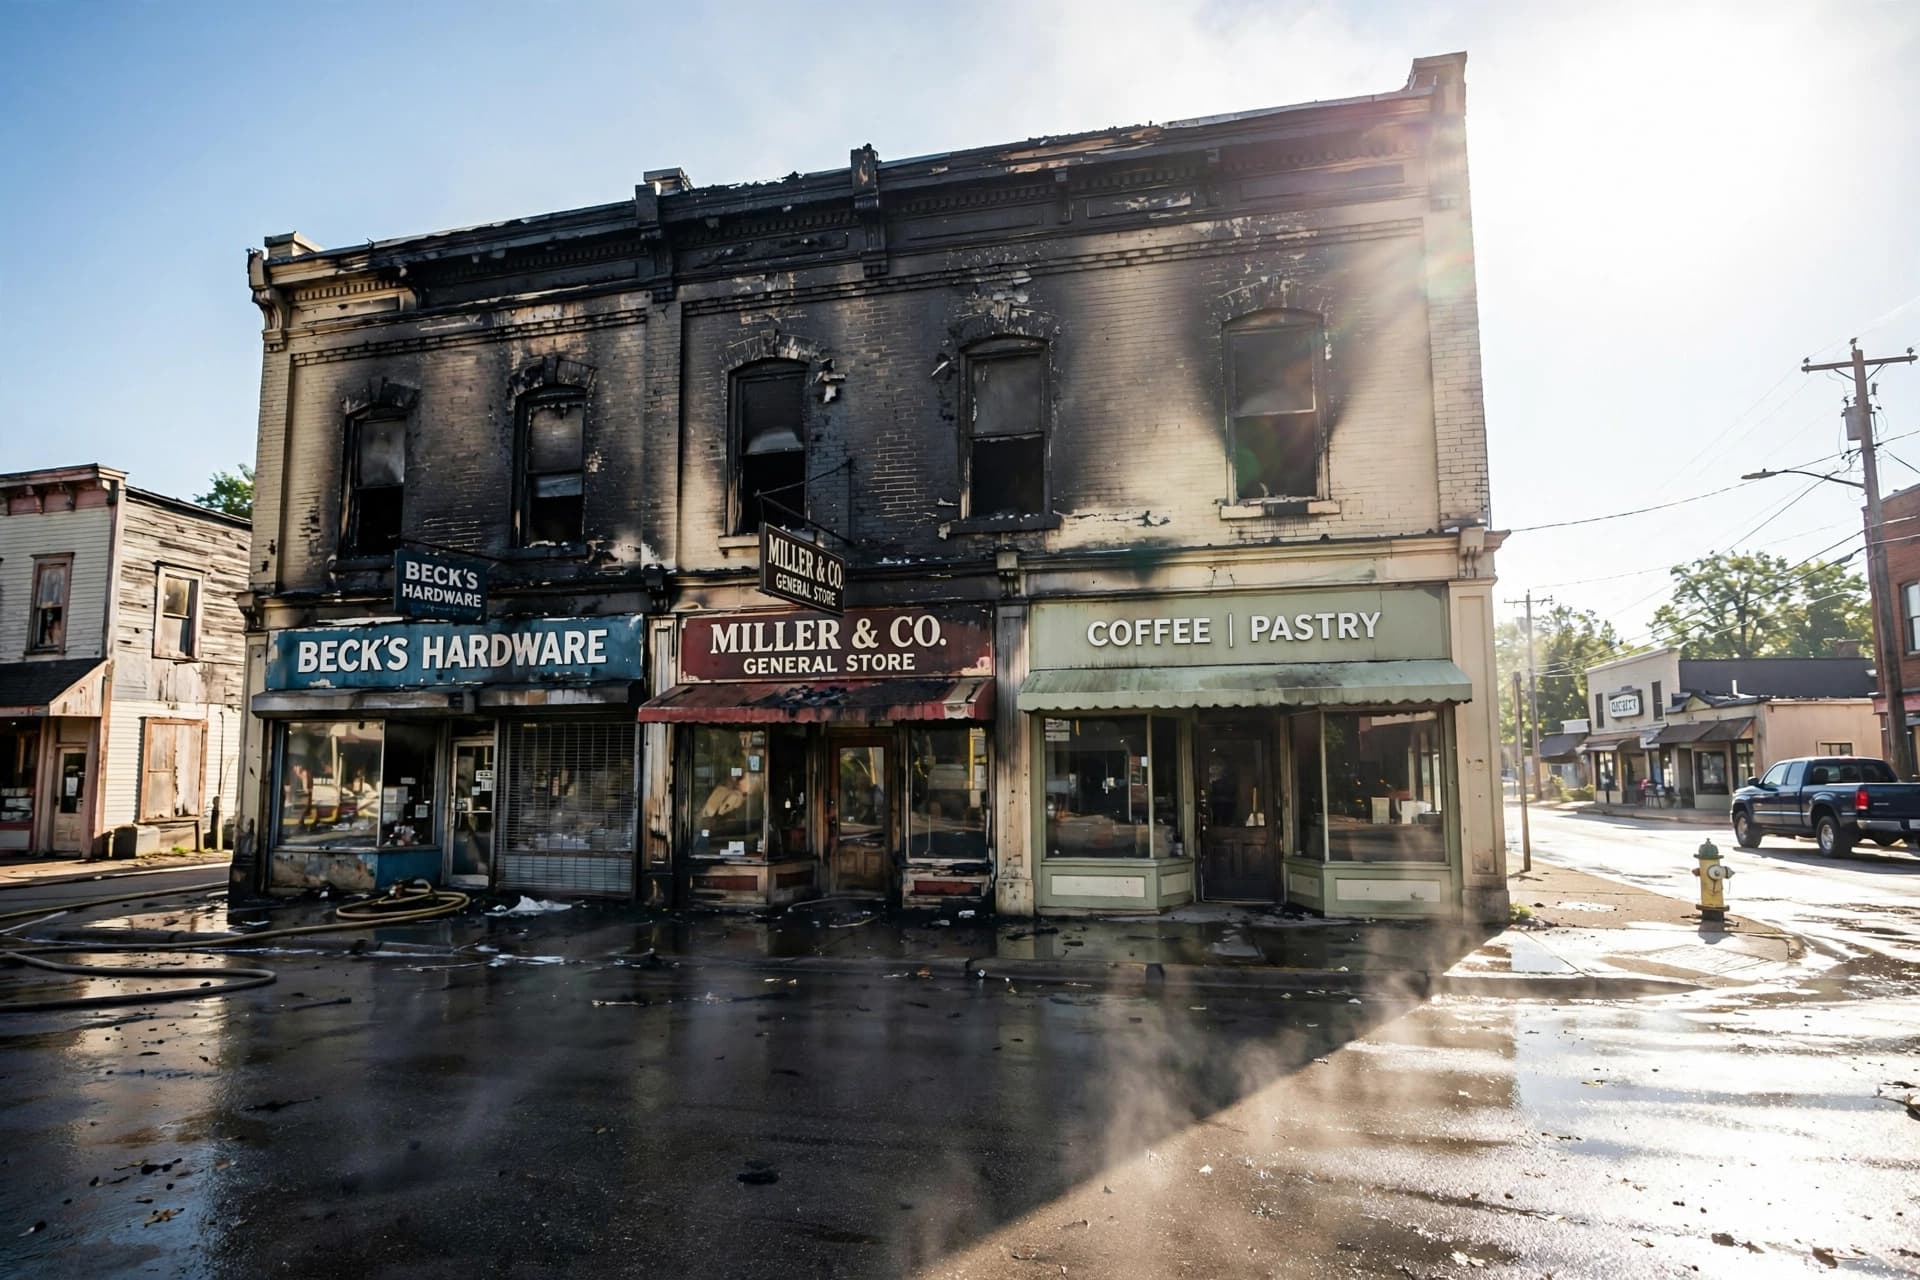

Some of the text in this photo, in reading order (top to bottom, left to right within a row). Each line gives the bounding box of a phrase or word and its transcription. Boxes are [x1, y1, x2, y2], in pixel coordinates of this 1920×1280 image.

[405, 560, 478, 590] BECK'S
[768, 534, 843, 591] MILLER & CO.
[402, 583, 482, 608] HARDWARE
[776, 573, 836, 606] GENERAL STORE
[710, 614, 947, 654] MILLER & CO.
[1087, 617, 1211, 647] COFFEE
[1250, 611, 1382, 642] PASTRY
[298, 629, 608, 673] BECK'S HARDWARE
[743, 653, 915, 675] GENERAL STORE
